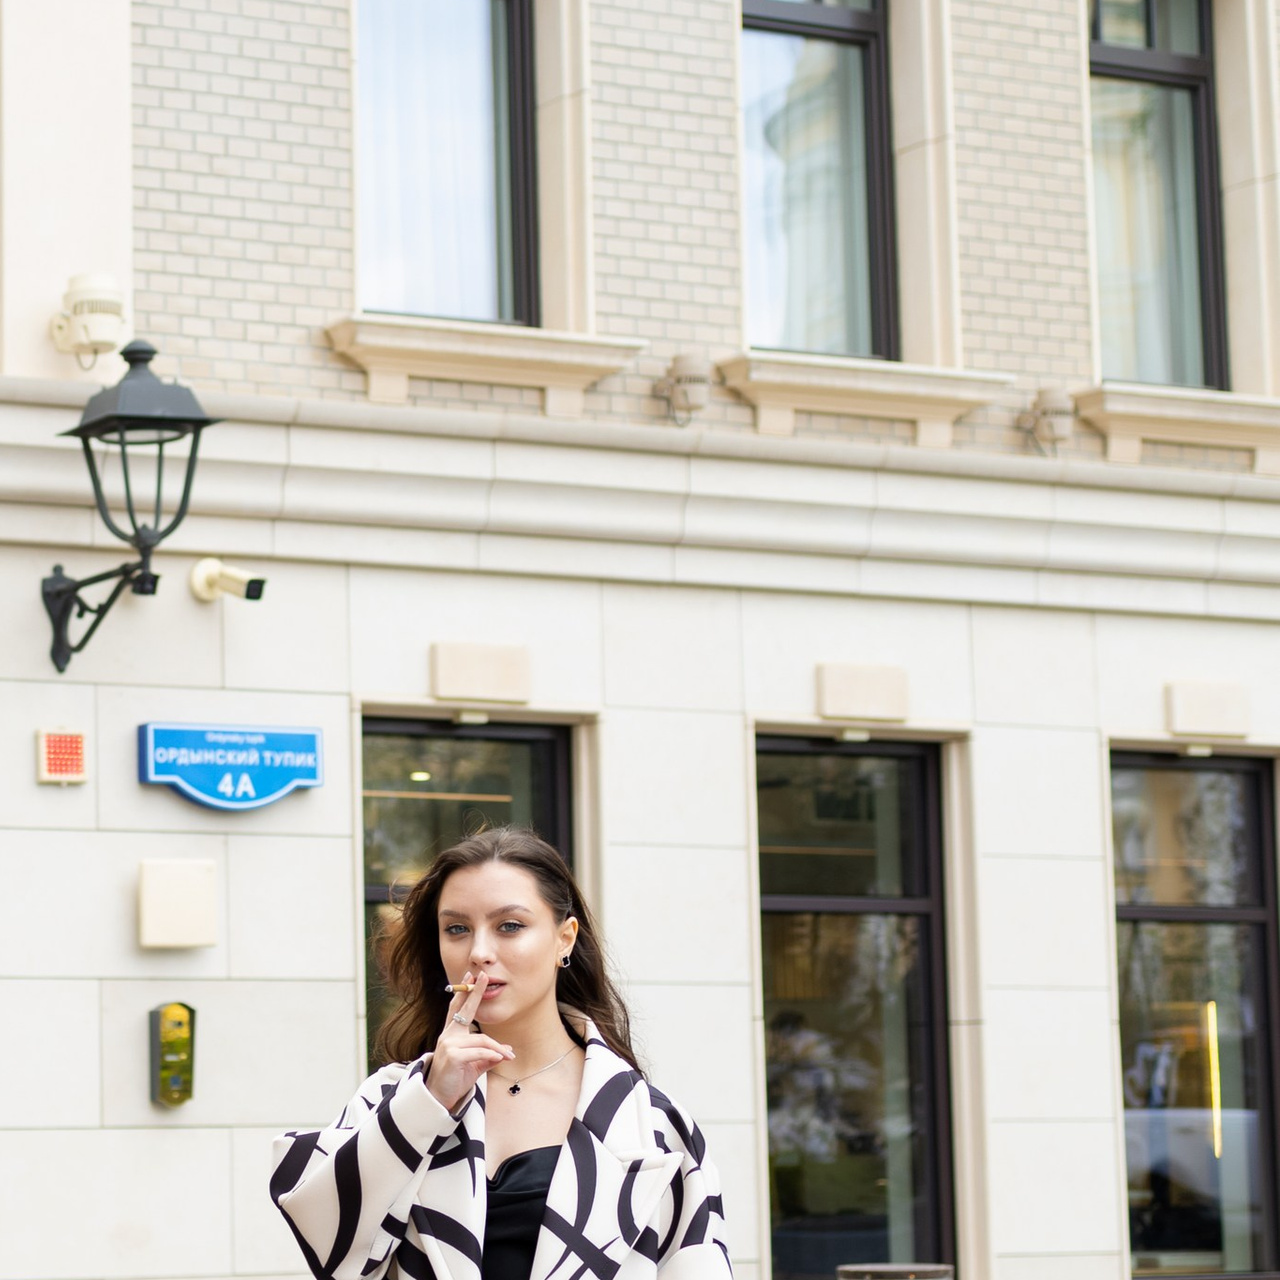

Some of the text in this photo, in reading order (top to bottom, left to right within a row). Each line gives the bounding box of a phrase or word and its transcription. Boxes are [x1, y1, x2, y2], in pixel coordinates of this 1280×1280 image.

[154, 747, 317, 768] ОРДЫНСКИЙ ТУПИК
[217, 772, 257, 798] 4А
